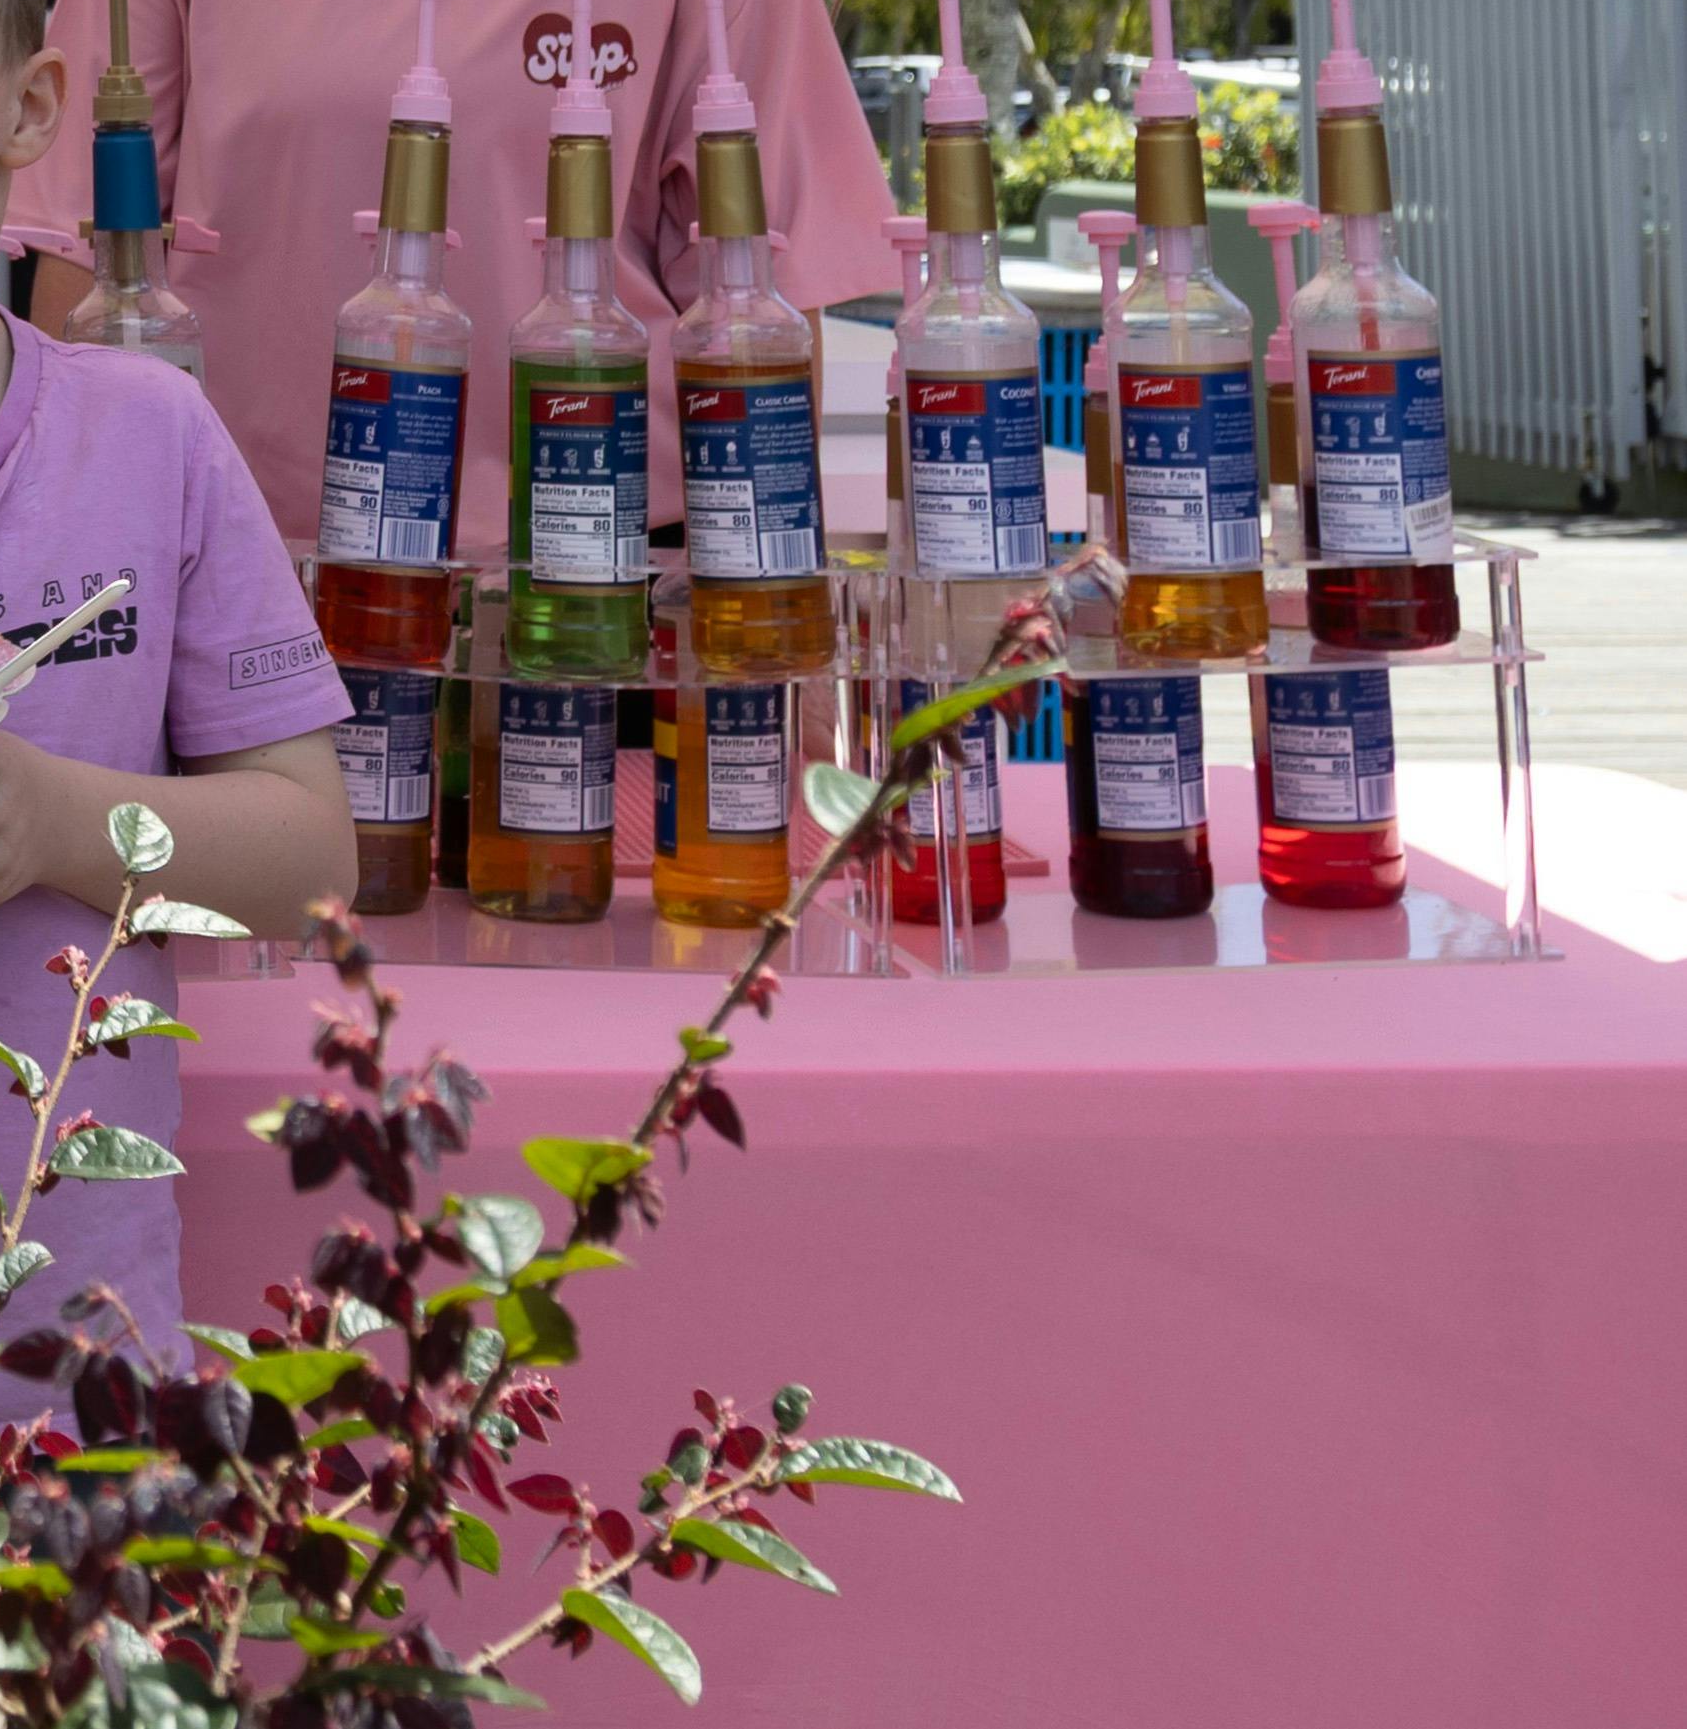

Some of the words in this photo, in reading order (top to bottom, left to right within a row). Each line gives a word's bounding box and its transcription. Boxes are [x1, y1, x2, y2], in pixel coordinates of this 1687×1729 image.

[527, 32, 636, 86] Sip.
[337, 371, 369, 392] Torani
[1323, 366, 1368, 390] Torani
[918, 385, 959, 409] Torani
[1131, 379, 1174, 403] Torani
[546, 396, 590, 419] Torani
[685, 391, 721, 415] Torani
[352, 462, 380, 475] Facts
[1365, 457, 1397, 467] Facts
[955, 466, 986, 477] Facts
[1169, 470, 1201, 481] Facts
[534, 485, 578, 497] Nutrition
[581, 487, 611, 498] Facts
[719, 481, 749, 493] Facts
[1319, 490, 1363, 502] Calories
[1378, 488, 1399, 502] 80
[359, 495, 378, 509] 90
[915, 500, 953, 511] Calories
[967, 499, 988, 511] 90
[1183, 502, 1203, 515] 80
[534, 519, 578, 531] Calories
[592, 519, 611, 532] 80
[732, 514, 751, 527] 80
[355, 727, 384, 738] Facts
[1318, 729, 1348, 739] Facts
[503, 736, 547, 748] Nutrition
[550, 738, 578, 749] Facts
[710, 738, 756, 747] Nutrition
[1096, 734, 1141, 746] Nutrition
[1145, 735, 1173, 746] Facts
[364, 758, 383, 771] 80
[1331, 760, 1351, 773] 80
[503, 768, 547, 781] Calories
[560, 770, 578, 782] 90
[711, 771, 756, 781] Calories
[1158, 766, 1175, 779] 90
